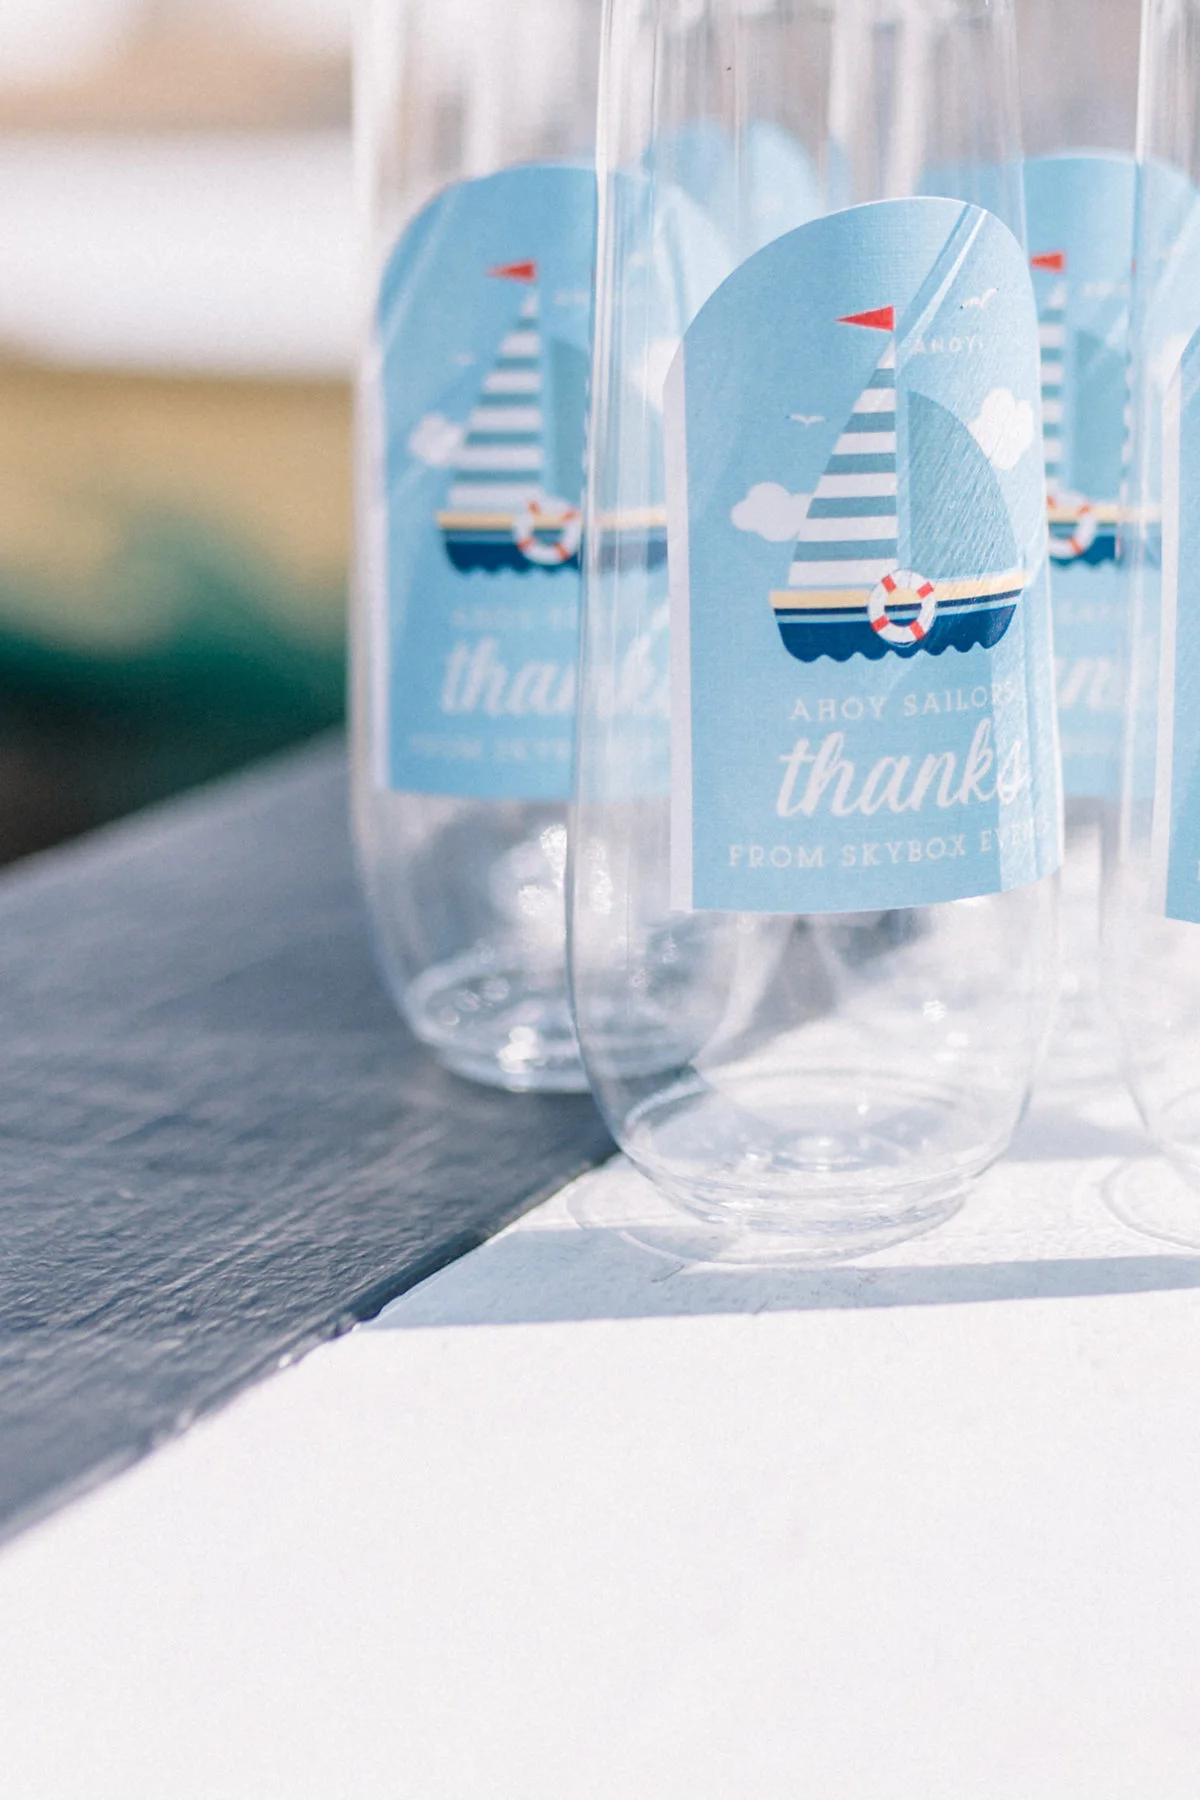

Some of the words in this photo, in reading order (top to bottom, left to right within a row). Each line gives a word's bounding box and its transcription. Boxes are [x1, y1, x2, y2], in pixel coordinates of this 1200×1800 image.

[789, 695, 886, 721] AHOY
[776, 717, 1033, 818] thanks
[728, 844, 825, 868] FROM
[841, 834, 967, 867] SKYBOX
